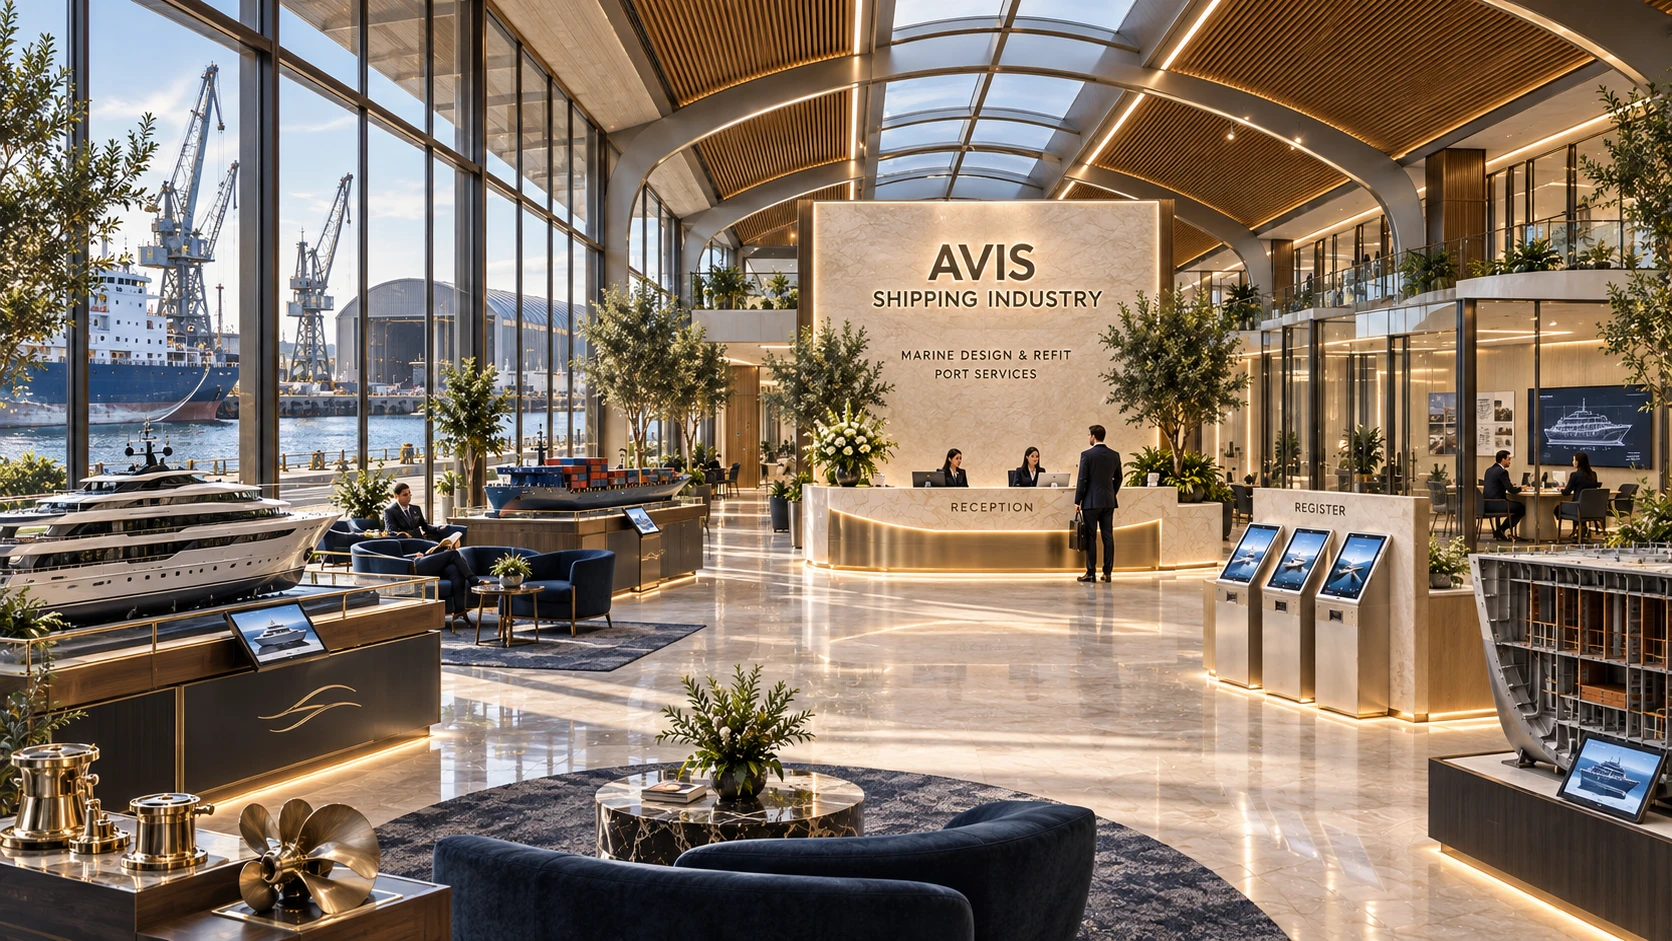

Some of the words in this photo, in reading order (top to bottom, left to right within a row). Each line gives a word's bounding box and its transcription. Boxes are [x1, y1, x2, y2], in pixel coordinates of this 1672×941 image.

[927, 243, 1036, 281] AVIS
[872, 290, 978, 308] SHIPPING
[988, 290, 1103, 308] INDUSTRY
[901, 350, 955, 361] MARINE
[960, 349, 1012, 361] DESIGN
[1018, 349, 1028, 361] &
[1033, 350, 1072, 361] REFIT
[935, 368, 969, 380] PORT
[974, 368, 1037, 380] SERVICES
[951, 502, 1033, 512] RECEPTION
[1294, 501, 1346, 516] REGISTER
